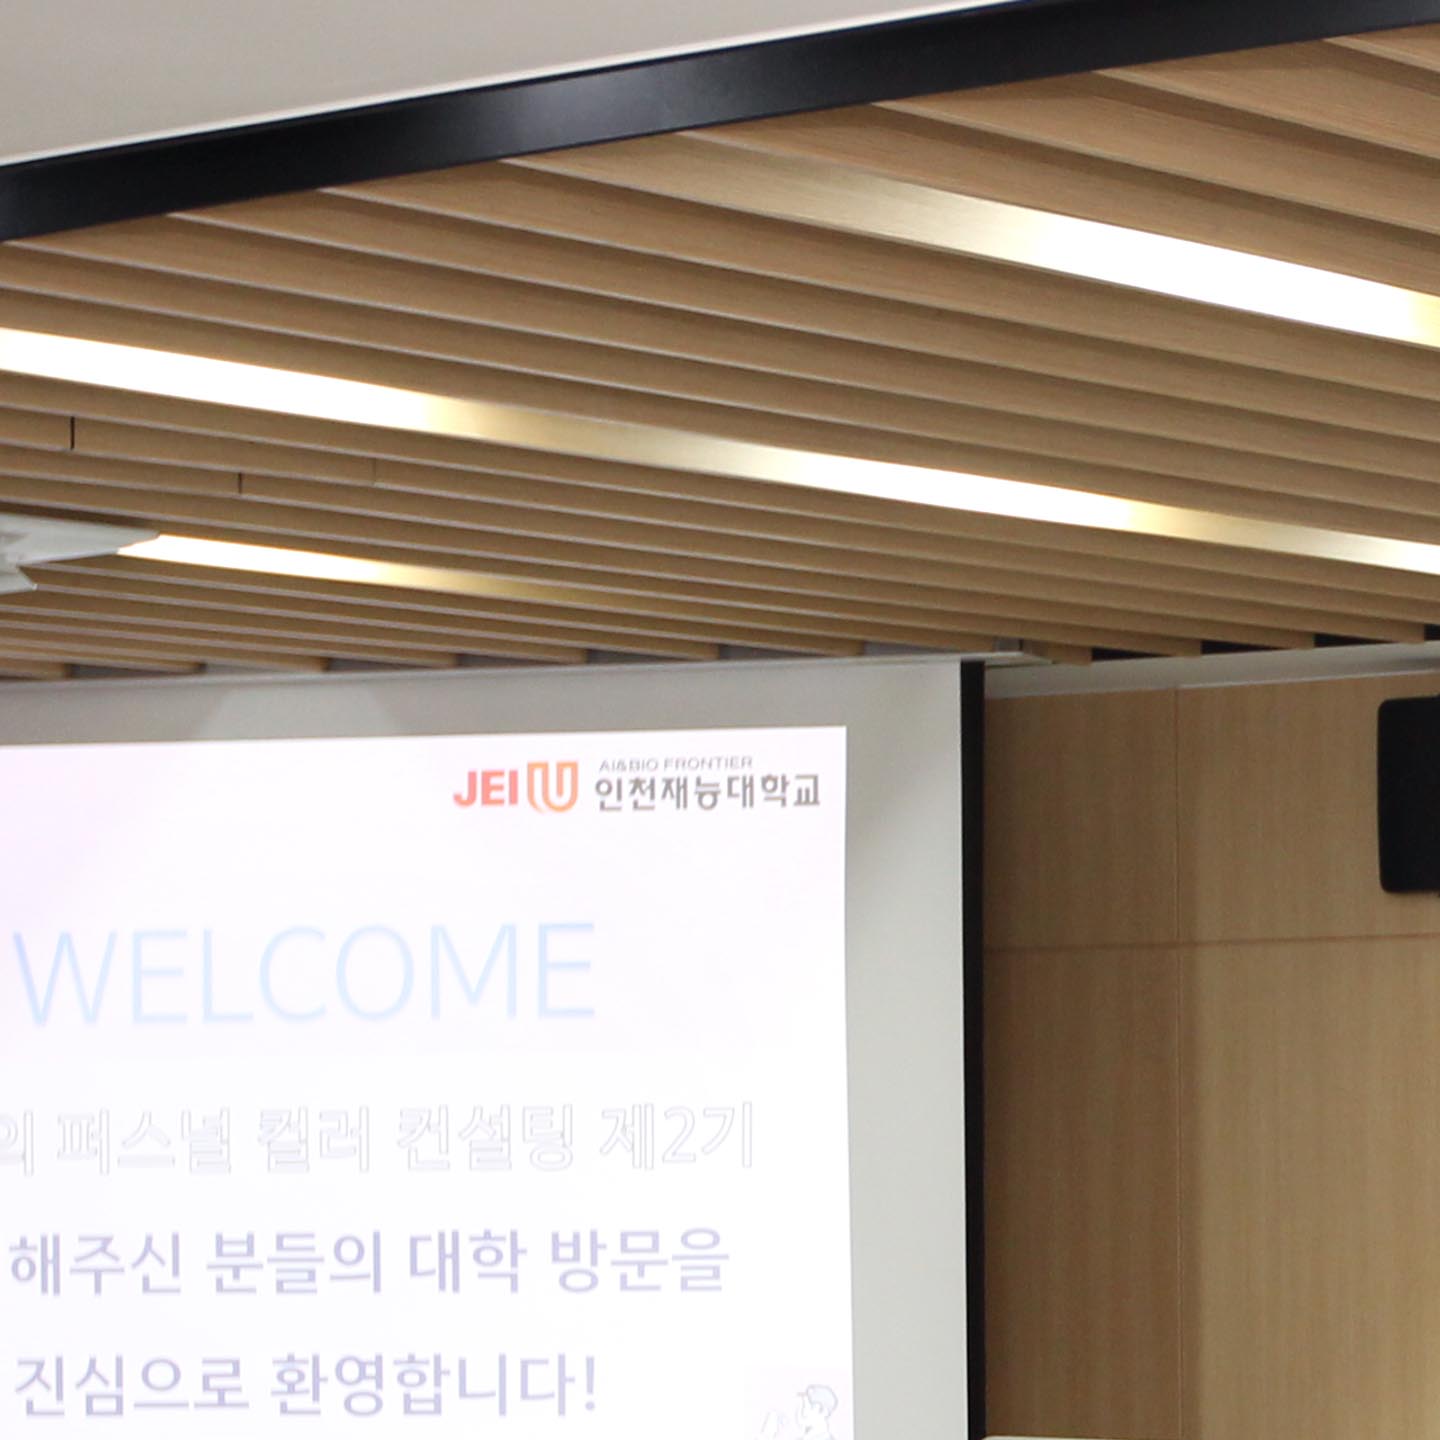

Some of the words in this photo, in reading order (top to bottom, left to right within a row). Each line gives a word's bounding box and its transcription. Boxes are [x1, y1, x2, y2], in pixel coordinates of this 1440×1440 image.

[595, 774, 820, 812] 인천재능대학교
[664, 755, 753, 771] FRONTIER
[13, 921, 596, 1029] WELCOME
[57, 1107, 231, 1175] 퍼스널
[258, 1106, 369, 1173] 컬러
[397, 1104, 574, 1172] 컨설팅
[599, 1102, 752, 1171] 제2기
[9, 1231, 181, 1296] 해주신
[207, 1230, 381, 1295] 분들의
[409, 1229, 527, 1294] 대학
[551, 1227, 729, 1293] 방문을
[15, 1354, 249, 1418] 진심으로
[271, 1353, 595, 1417] 환영합니다!
